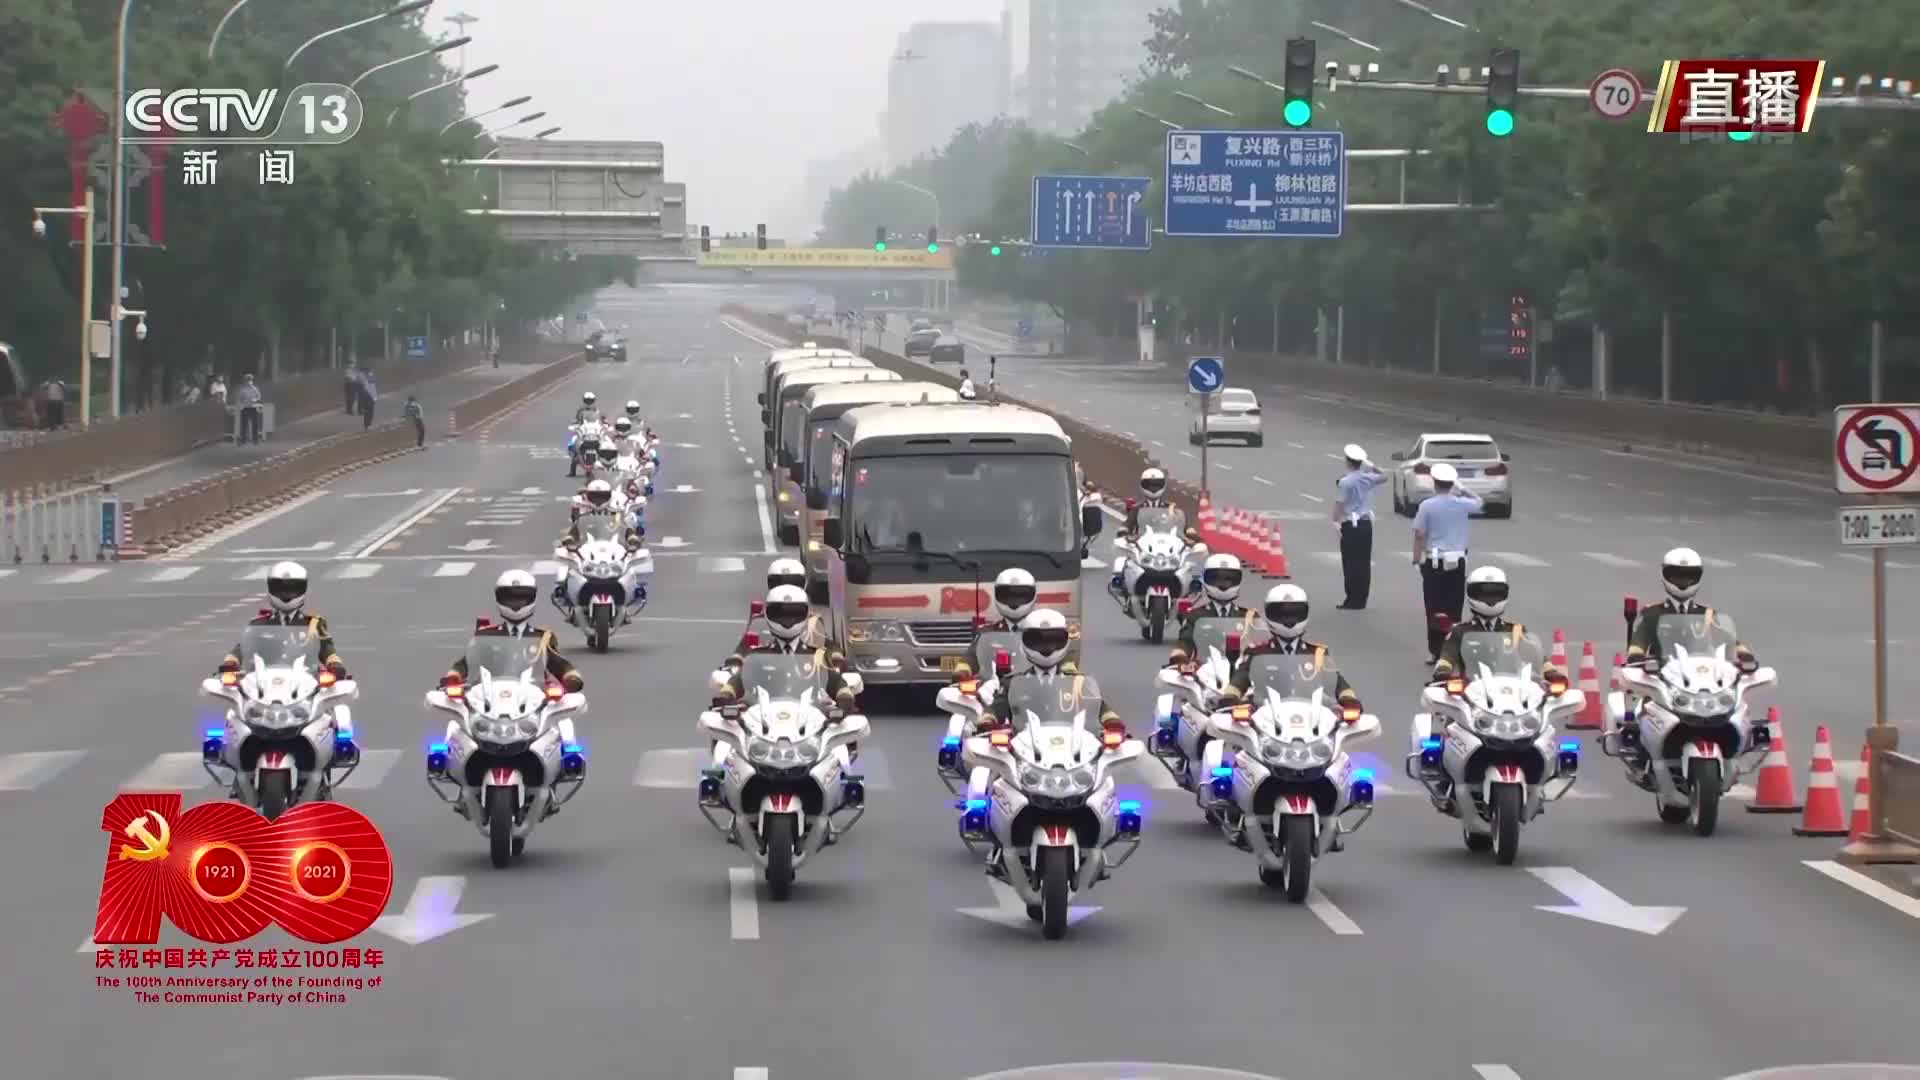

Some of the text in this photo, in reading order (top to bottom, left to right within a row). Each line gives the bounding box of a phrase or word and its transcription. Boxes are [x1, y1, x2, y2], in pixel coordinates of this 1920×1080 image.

[1603, 86, 1630, 106] 70
[1225, 136, 1281, 156] 复兴路
[1171, 174, 1233, 193] 羊坊店西路
[1275, 174, 1337, 193] 柳林馆路
